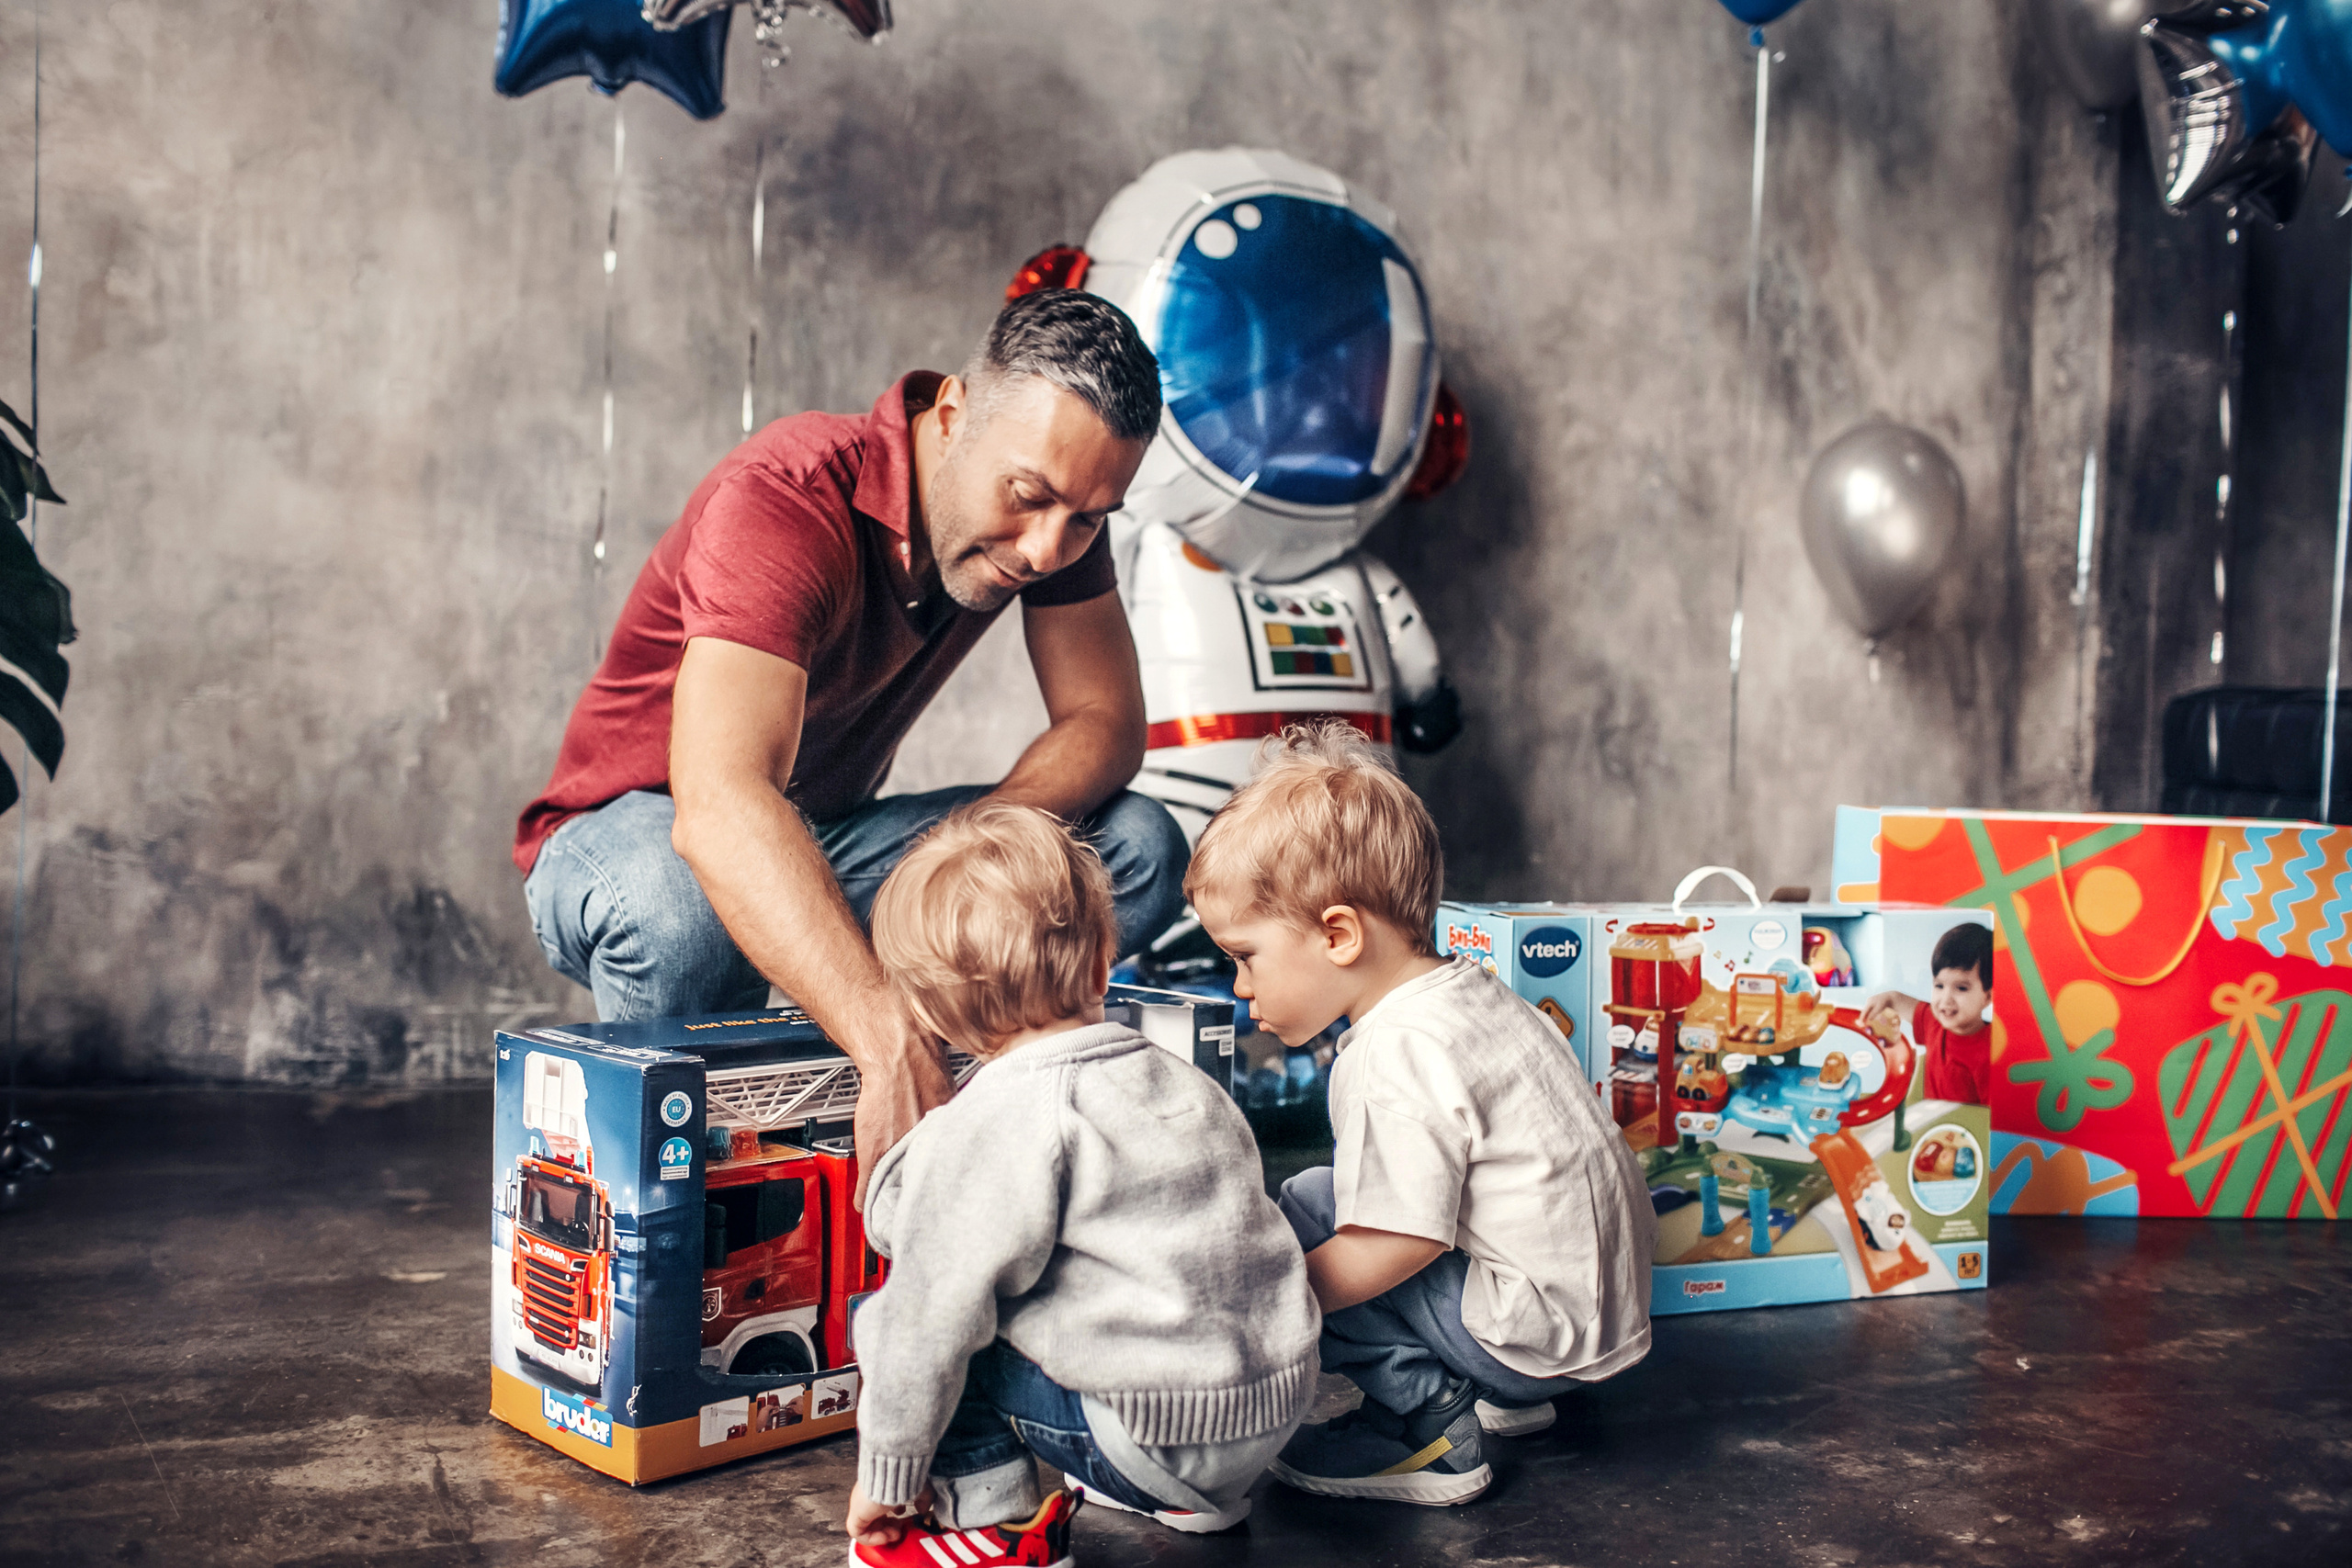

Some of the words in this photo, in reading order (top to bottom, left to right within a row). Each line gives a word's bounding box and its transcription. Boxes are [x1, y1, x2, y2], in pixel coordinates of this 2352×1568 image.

[1521, 940, 1577, 958] vtech
[662, 1144, 689, 1164] 4+
[535, 1243, 566, 1265] SCANIA
[544, 1387, 610, 1443] bruder
